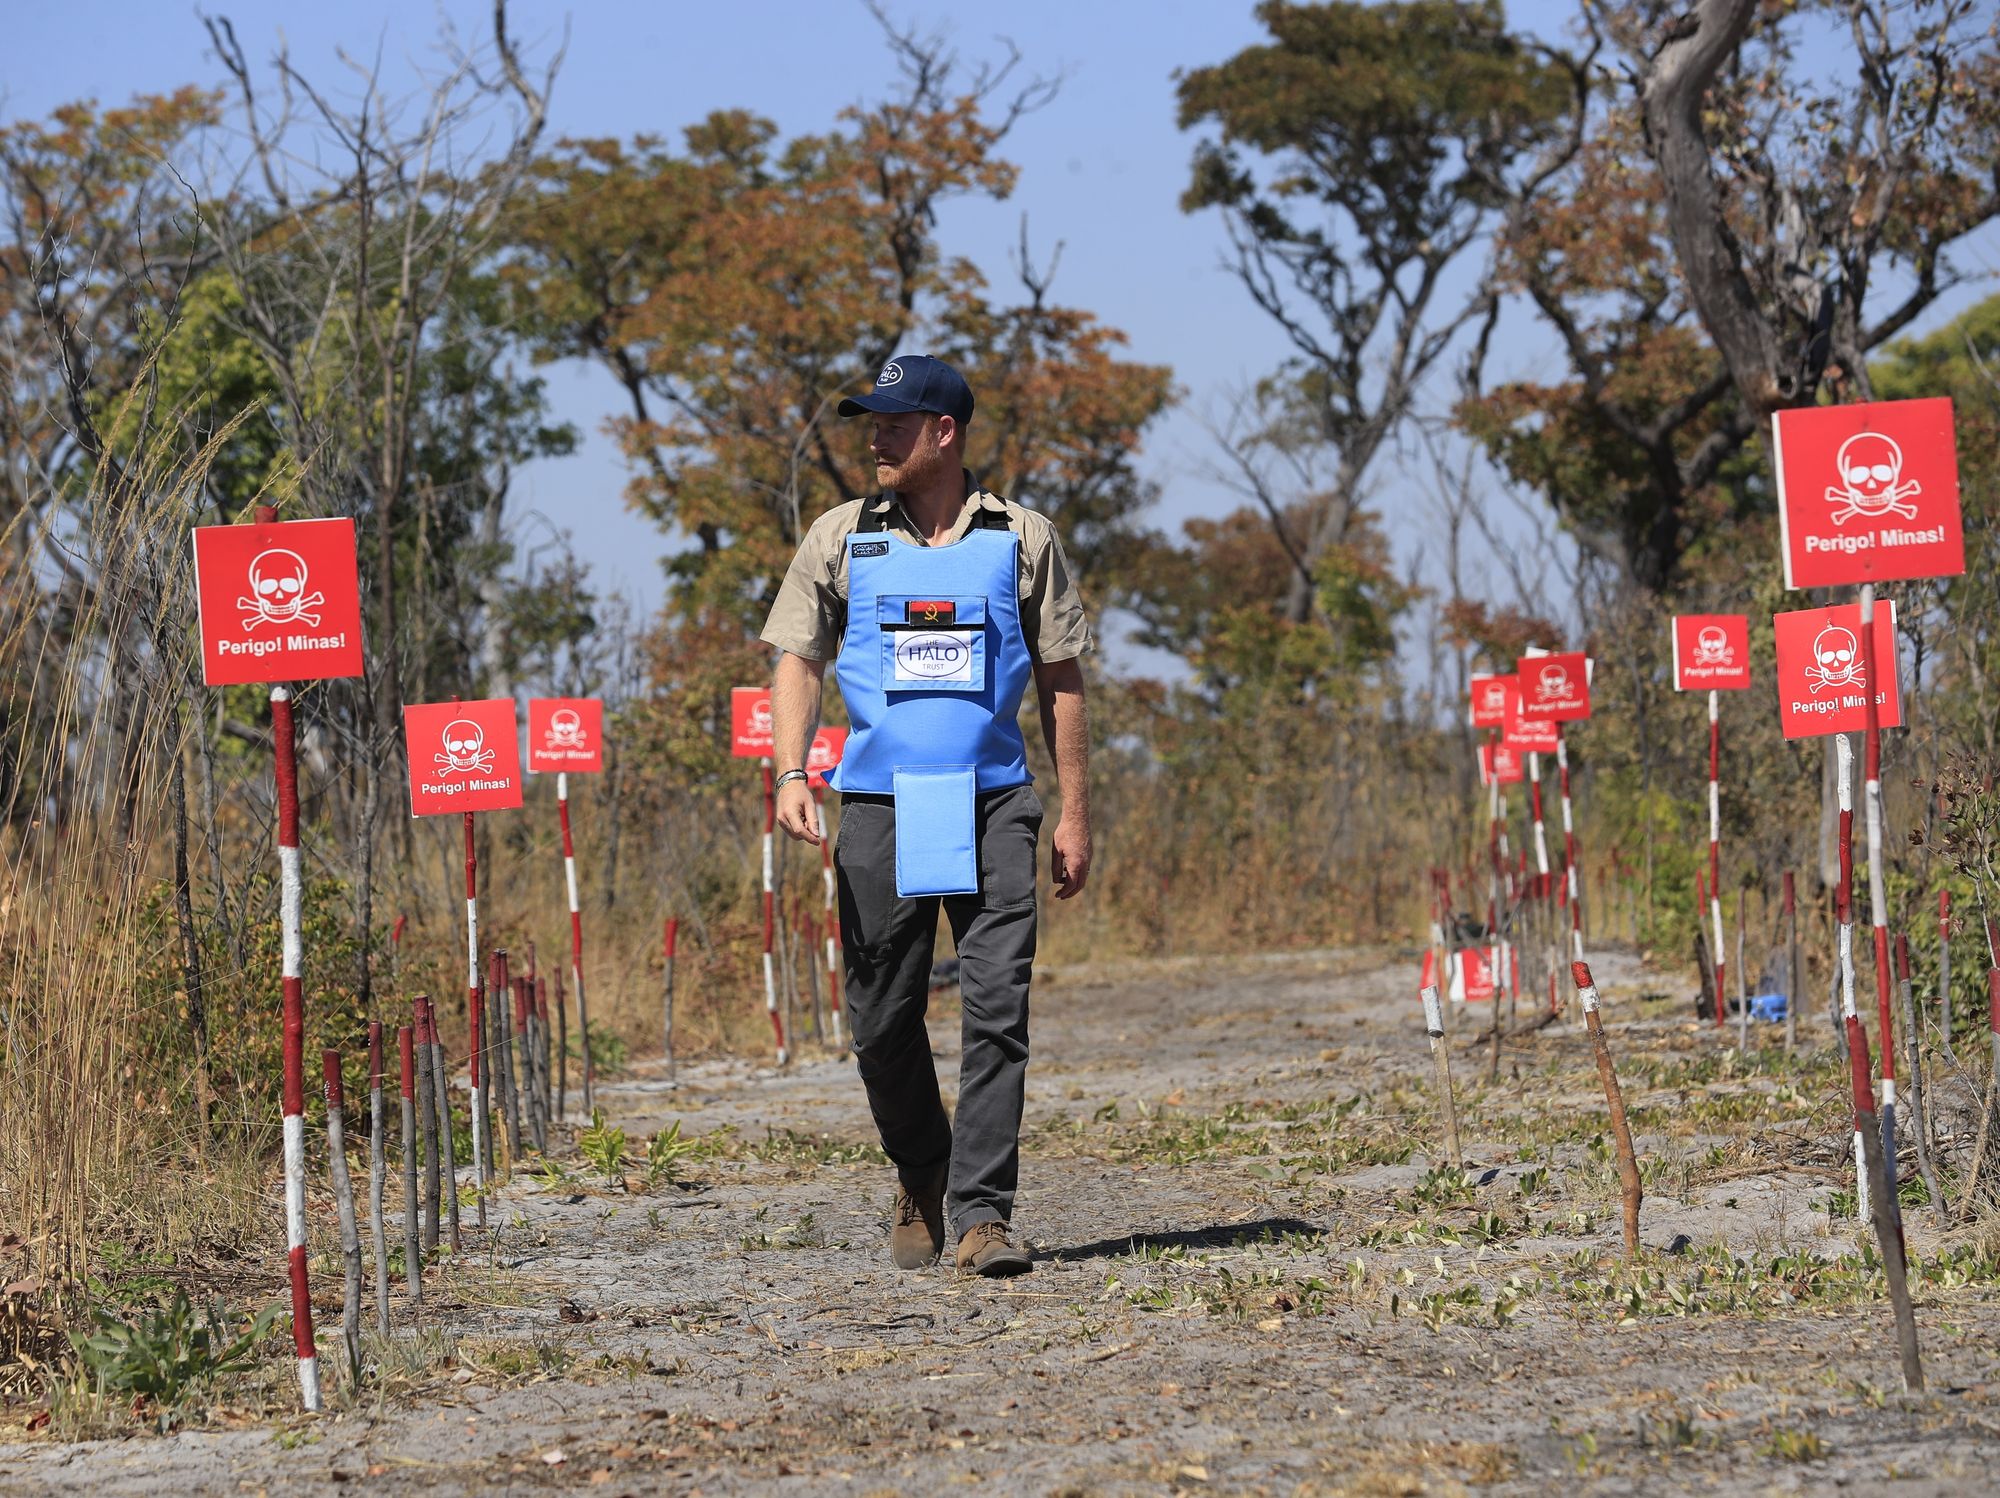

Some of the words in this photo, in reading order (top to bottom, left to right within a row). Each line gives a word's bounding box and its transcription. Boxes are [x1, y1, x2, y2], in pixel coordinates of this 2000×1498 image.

[1804, 531, 1875, 554] Perigo!
[1880, 525, 1946, 548] Minas!
[218, 636, 282, 657] Perigo!
[287, 632, 346, 651] Minas!
[909, 646, 959, 661] HALO
[923, 663, 945, 671] TRUST
[1684, 666, 1714, 678] Perigo!
[1792, 697, 1838, 714] Perigo!
[1843, 691, 1886, 708] Mins!
[421, 780, 466, 795] Perigo!
[469, 777, 510, 792] Minas!
